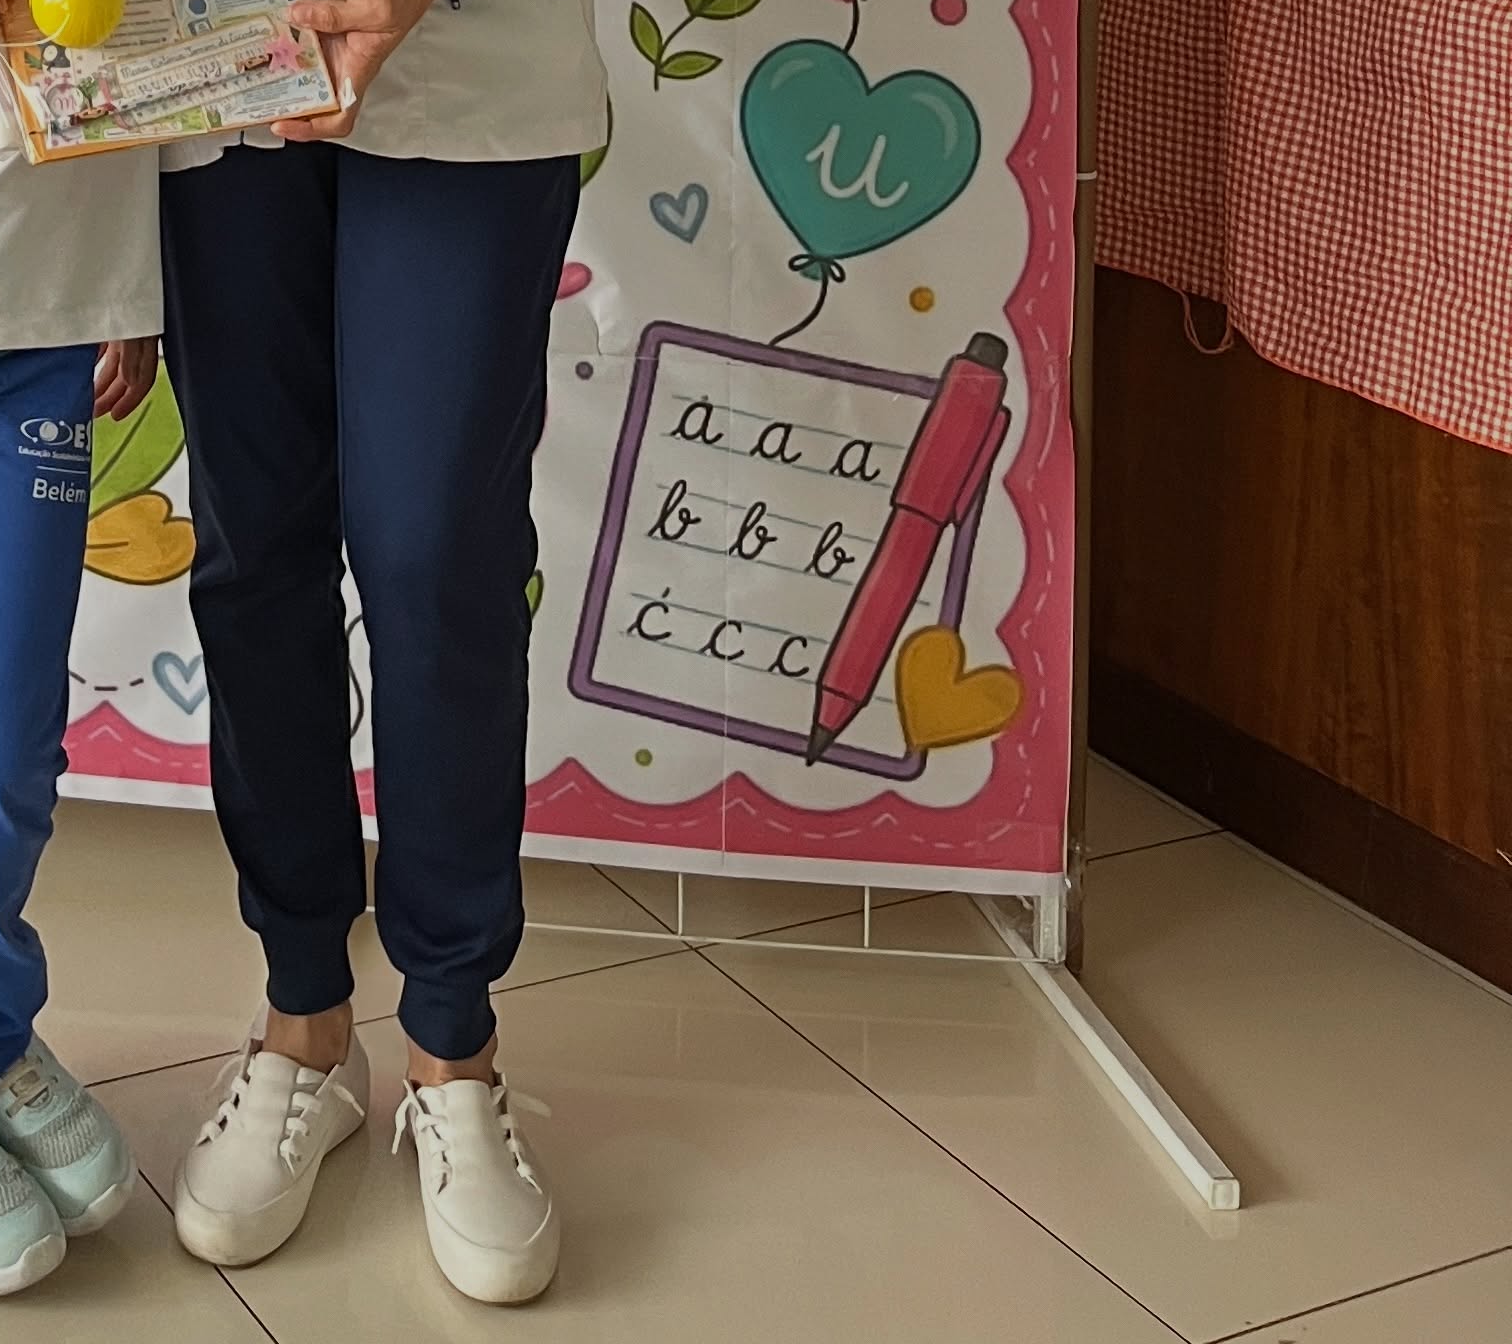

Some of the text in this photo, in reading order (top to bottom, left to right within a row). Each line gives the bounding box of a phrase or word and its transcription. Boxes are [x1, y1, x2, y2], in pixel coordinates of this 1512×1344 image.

[805, 124, 909, 208] u
[750, 422, 803, 464] a
[830, 438, 881, 482] a
[32, 478, 86, 504] Belém
[648, 479, 856, 581] b b b
[699, 620, 746, 661] c
[768, 635, 810, 678] c
